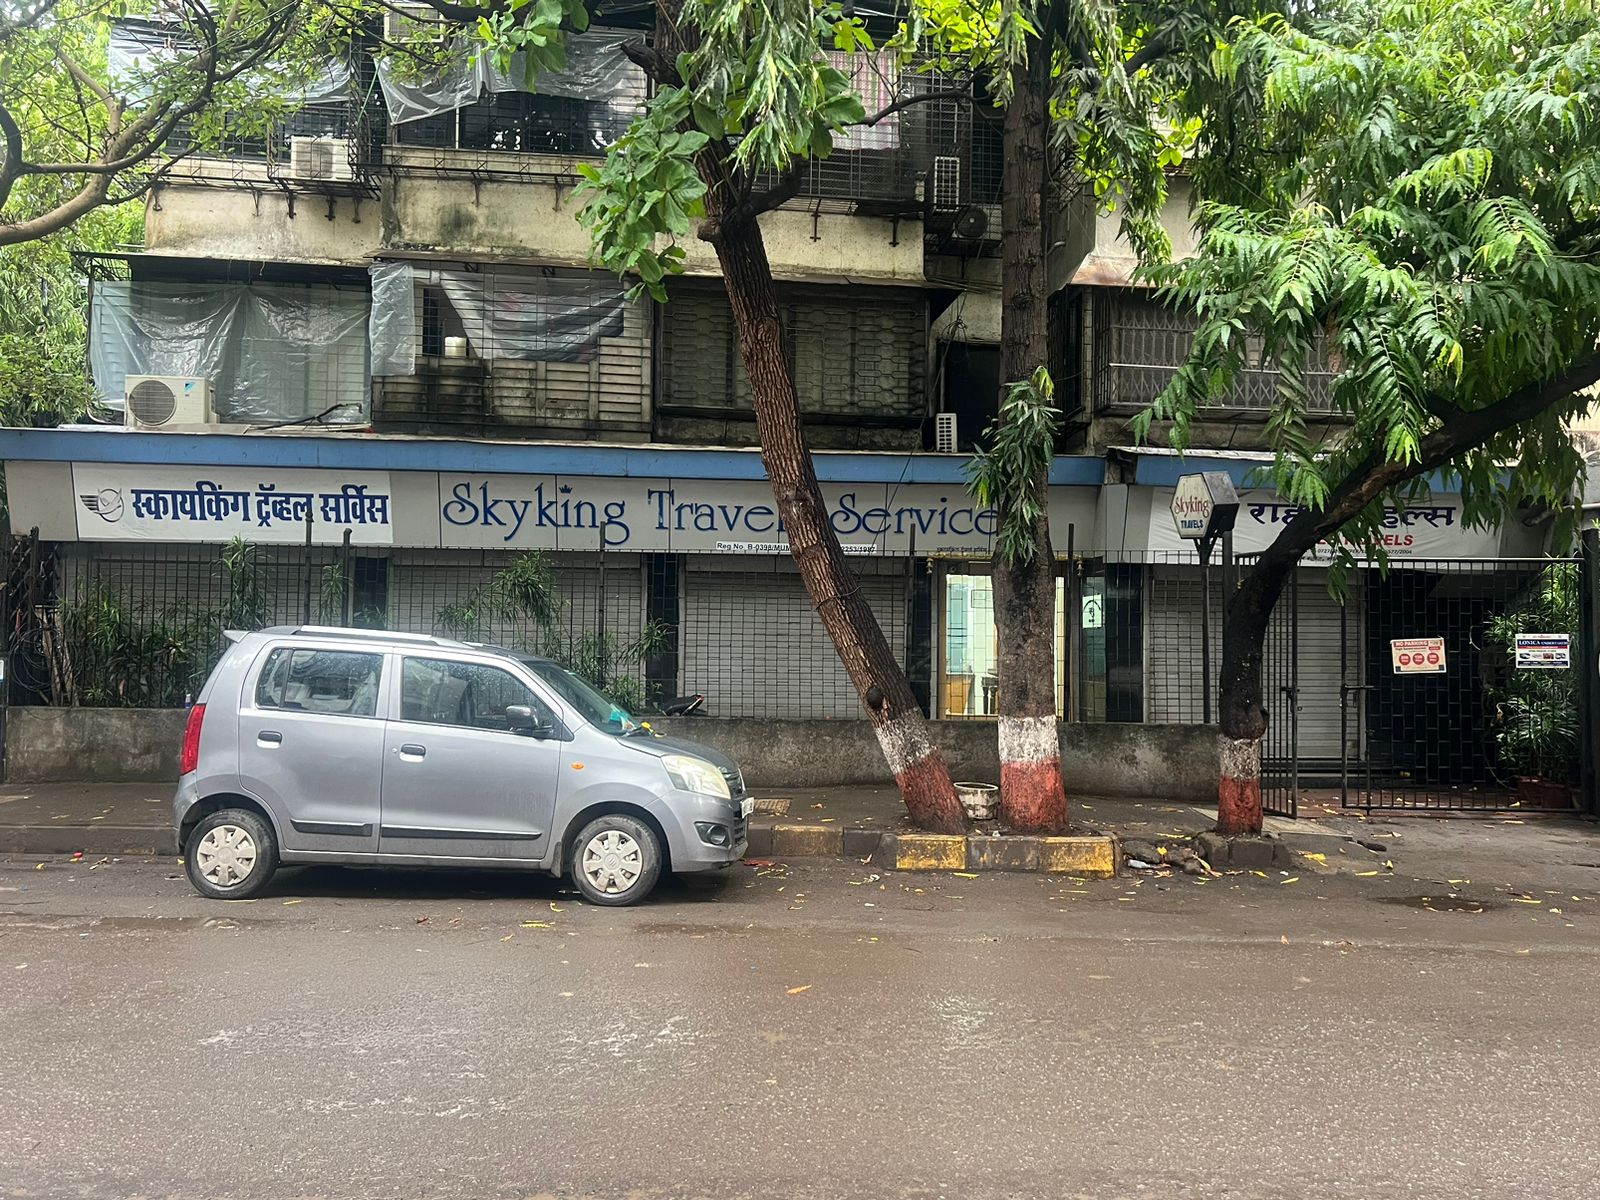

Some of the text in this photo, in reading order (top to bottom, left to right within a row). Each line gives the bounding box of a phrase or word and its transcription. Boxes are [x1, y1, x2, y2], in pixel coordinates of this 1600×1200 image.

[131, 481, 251, 521] स्कायकिंग
[319, 484, 389, 524] सर्विस
[443, 481, 630, 545] Skyking
[829, 492, 998, 535] Service
[1174, 495, 1210, 518] Skyking
[1180, 520, 1204, 529] TRAVELS
[716, 542, 732, 551] Reg
